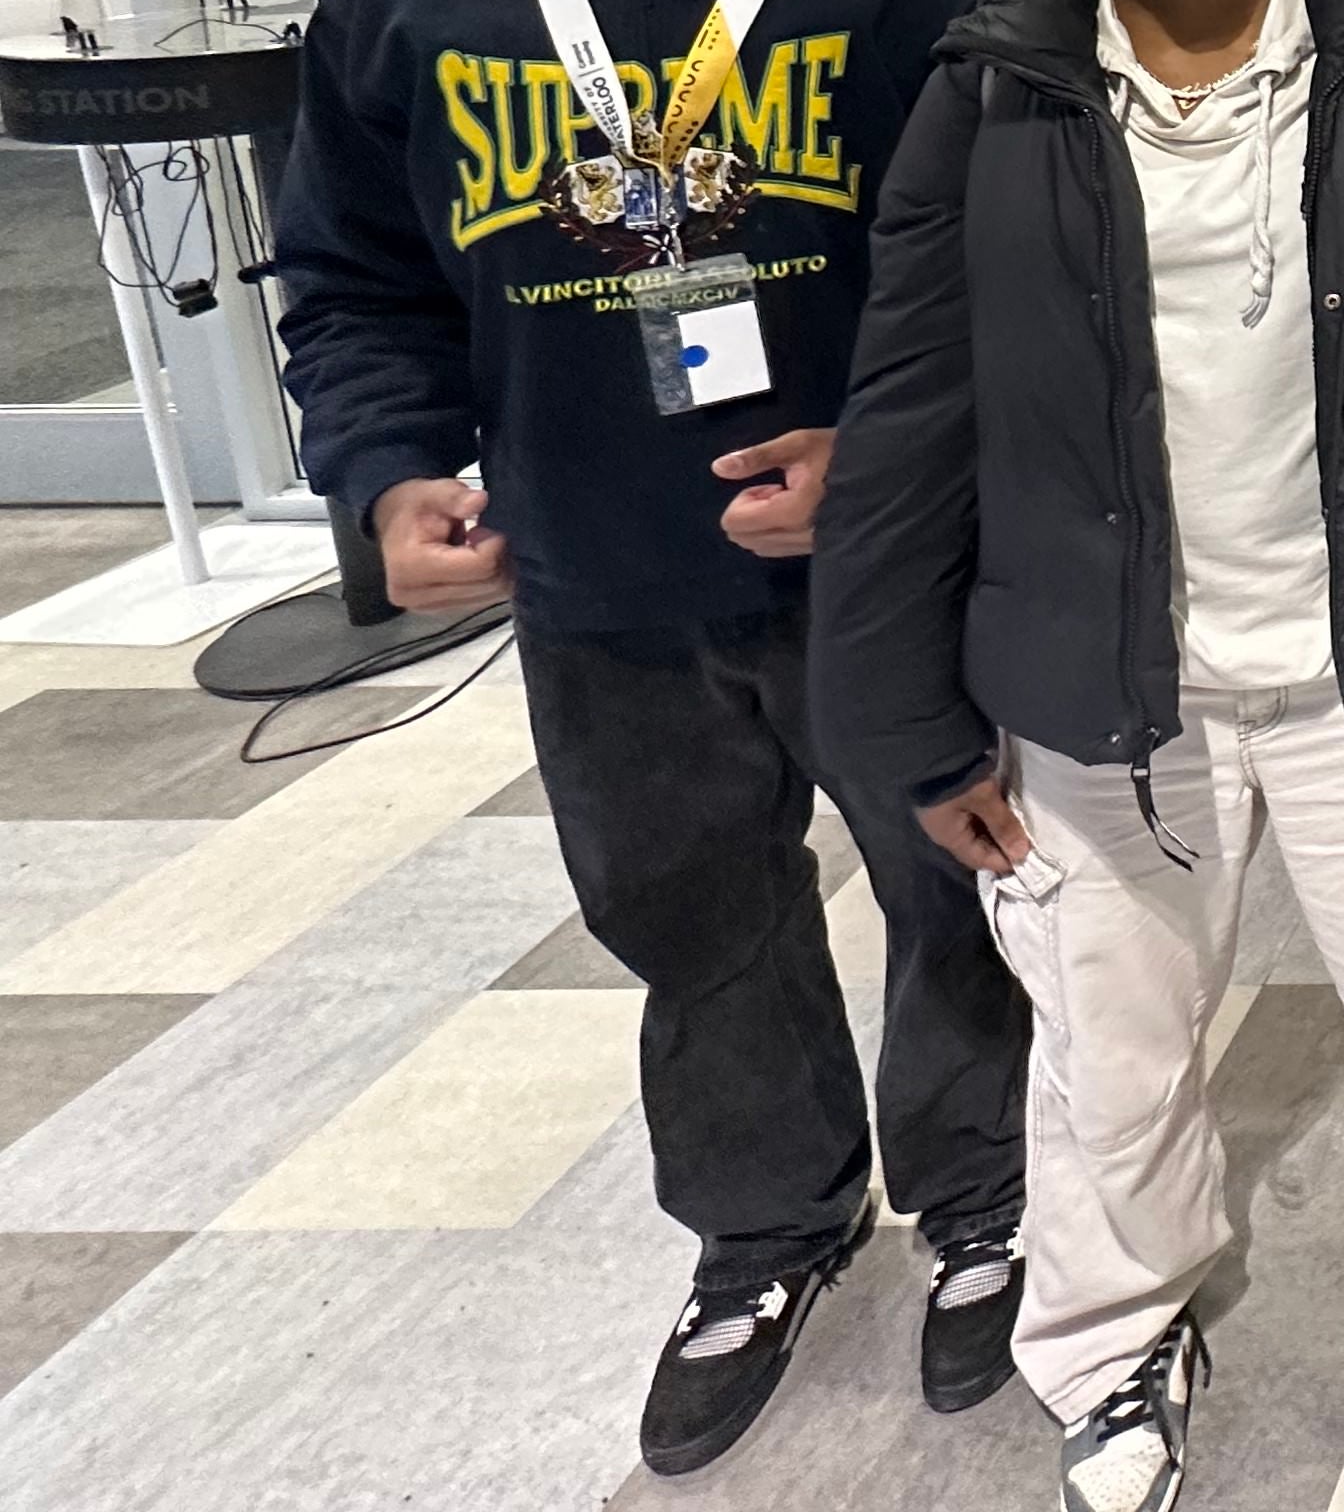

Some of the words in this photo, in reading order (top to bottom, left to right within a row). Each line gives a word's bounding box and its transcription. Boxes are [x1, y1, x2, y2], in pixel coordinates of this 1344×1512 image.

[38, 83, 211, 116] STATION
[437, 31, 851, 217] SUPME
[594, 296, 637, 313] DAL
